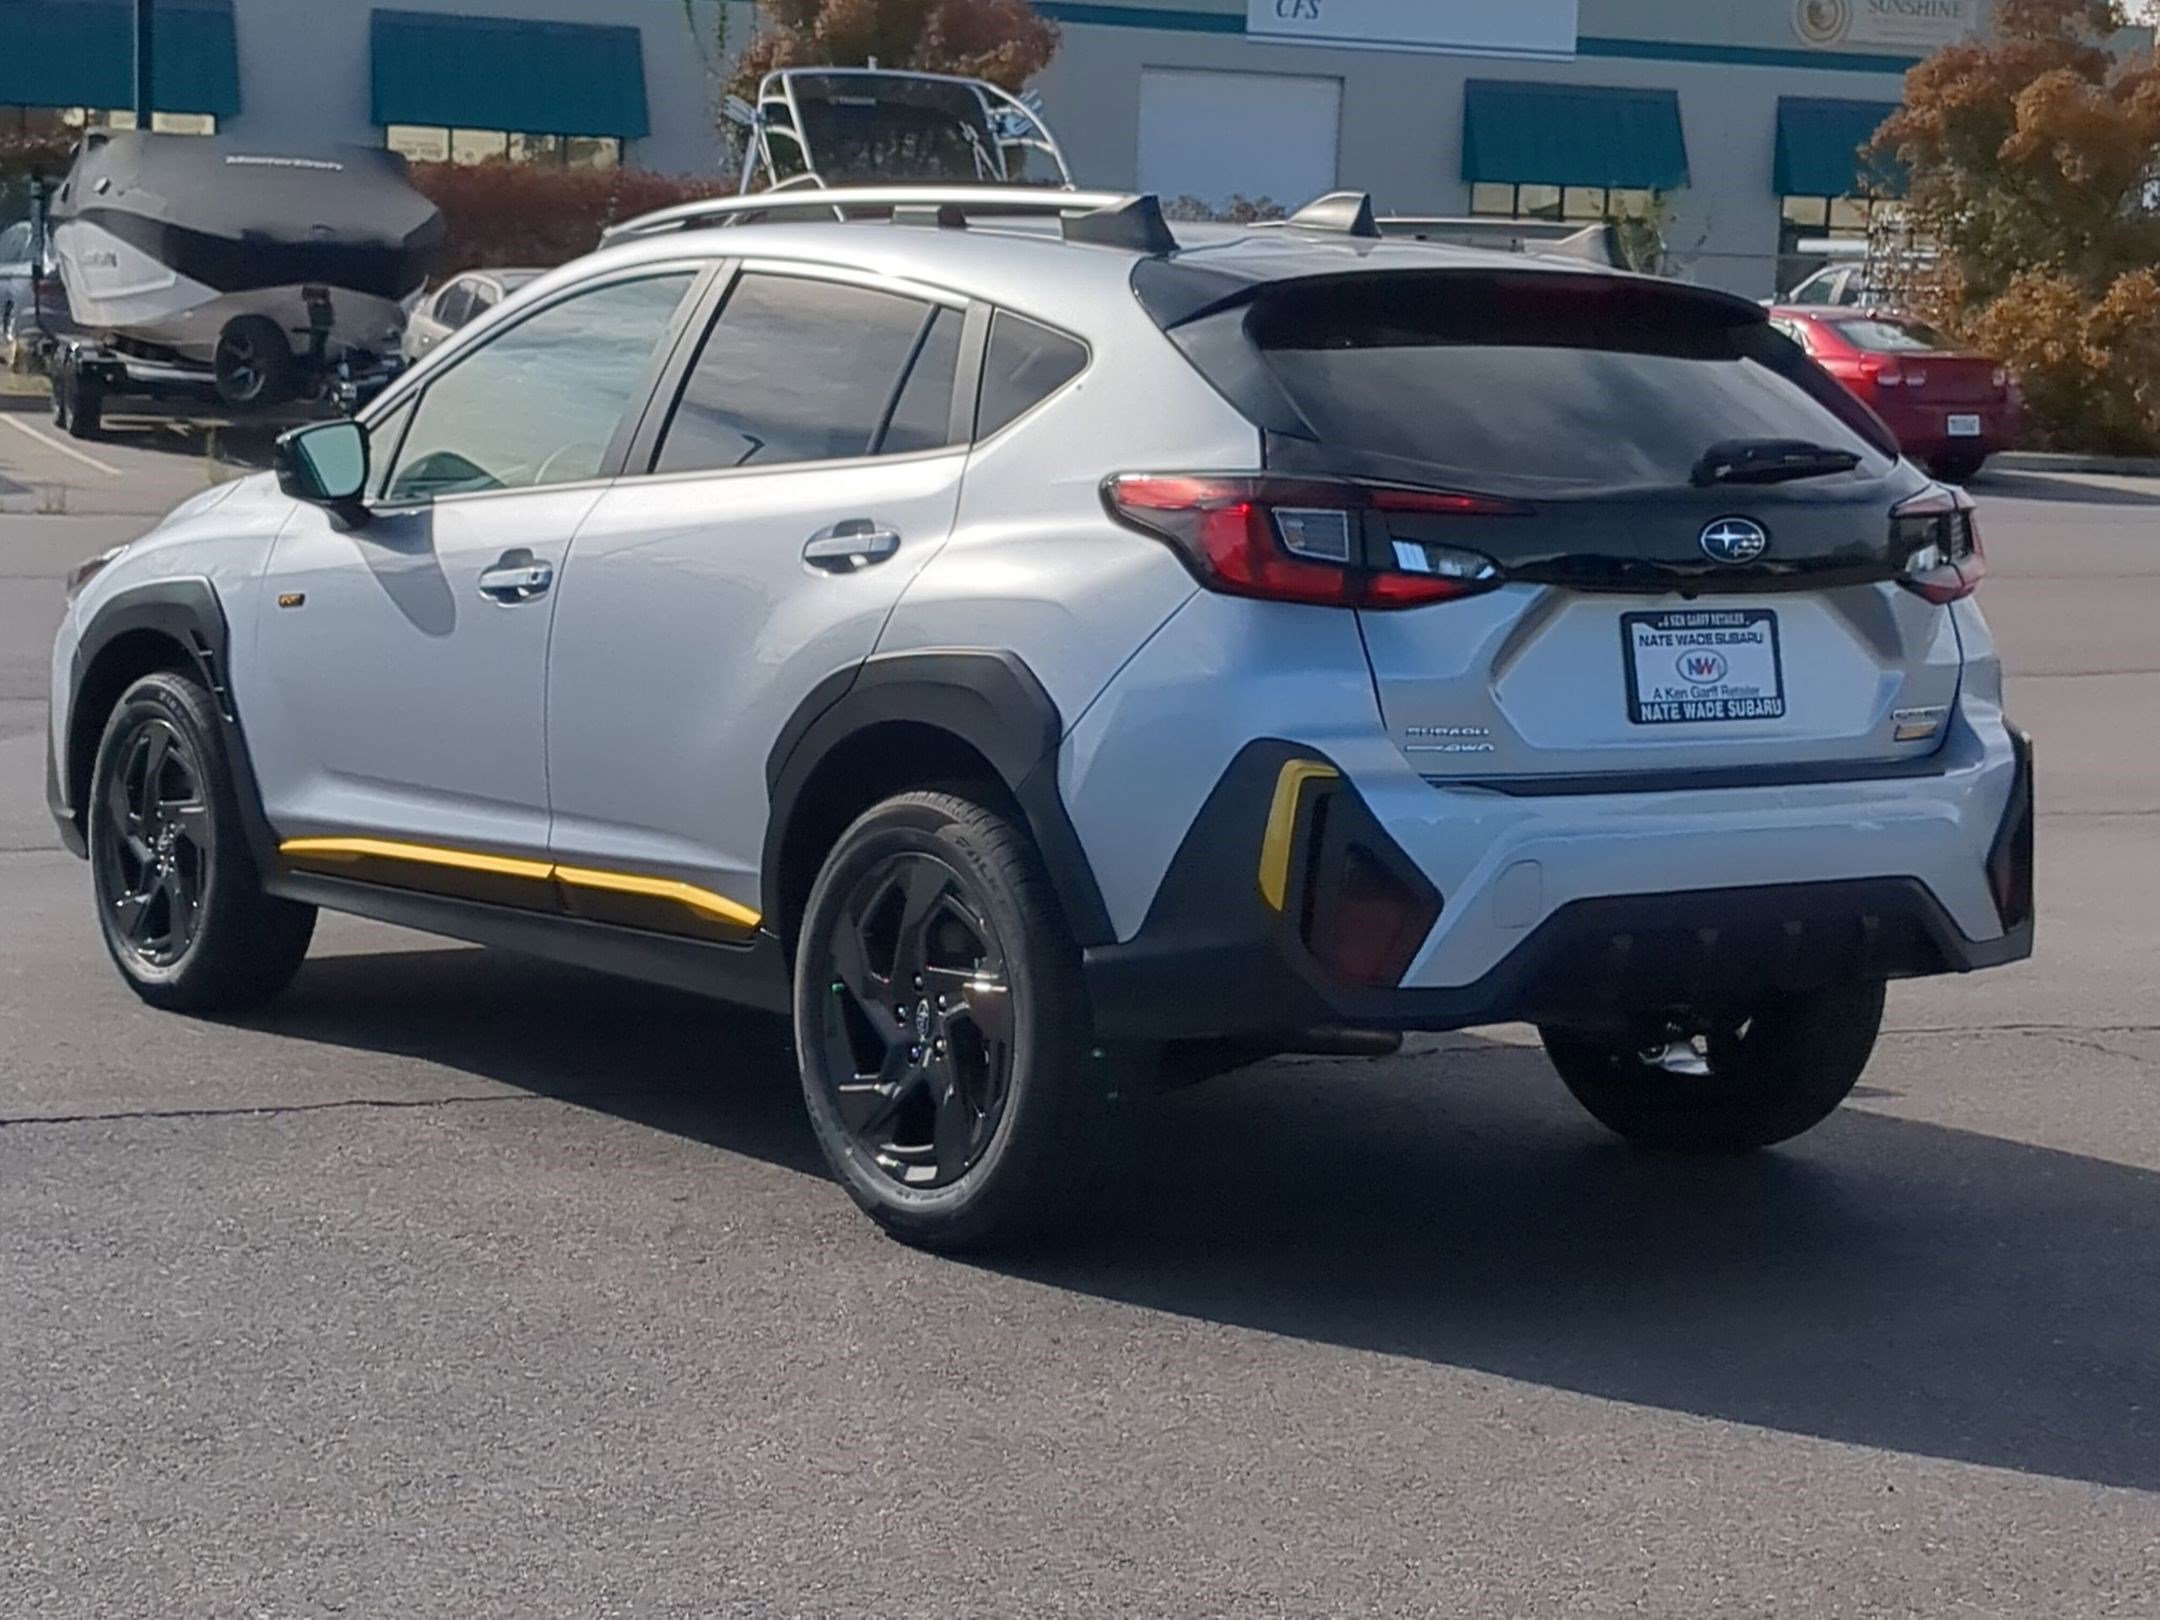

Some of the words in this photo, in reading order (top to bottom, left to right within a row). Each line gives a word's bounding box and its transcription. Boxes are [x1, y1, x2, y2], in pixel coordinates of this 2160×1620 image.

[1639, 634, 1673, 647] NATE
[1675, 633, 1714, 646] WADE
[1715, 632, 1763, 645] SUBARU
[1686, 657, 1718, 676] NW
[1653, 687, 1664, 700] A
[1665, 686, 1689, 699] Ken
[1641, 702, 1681, 721] NATE
[1682, 701, 1725, 719] WADE
[1727, 698, 1782, 717] SUBARU
